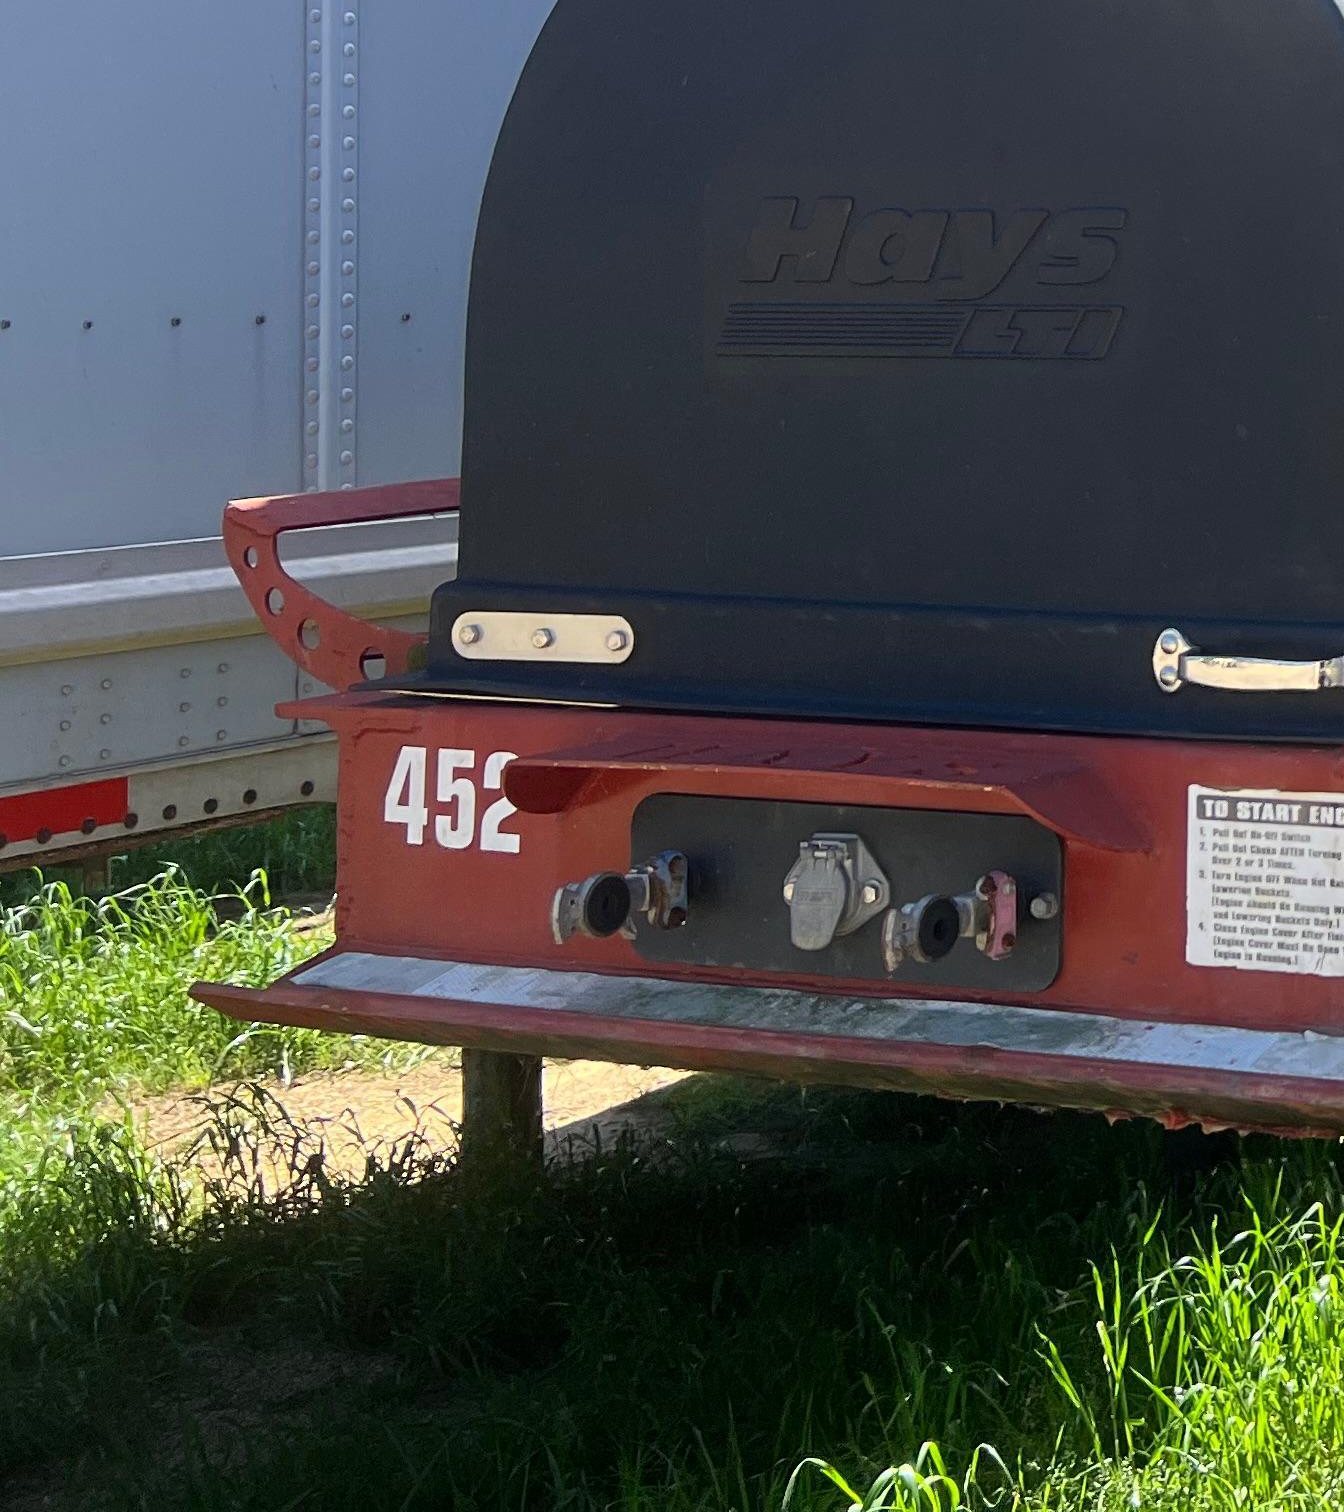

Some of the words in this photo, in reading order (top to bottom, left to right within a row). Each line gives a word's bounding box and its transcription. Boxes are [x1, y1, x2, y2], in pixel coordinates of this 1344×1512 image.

[738, 196, 1128, 302] Hays
[953, 306, 1124, 360] LTI
[384, 745, 521, 853] 452
[1203, 799, 1229, 818] TO
[1236, 801, 1302, 822] START
